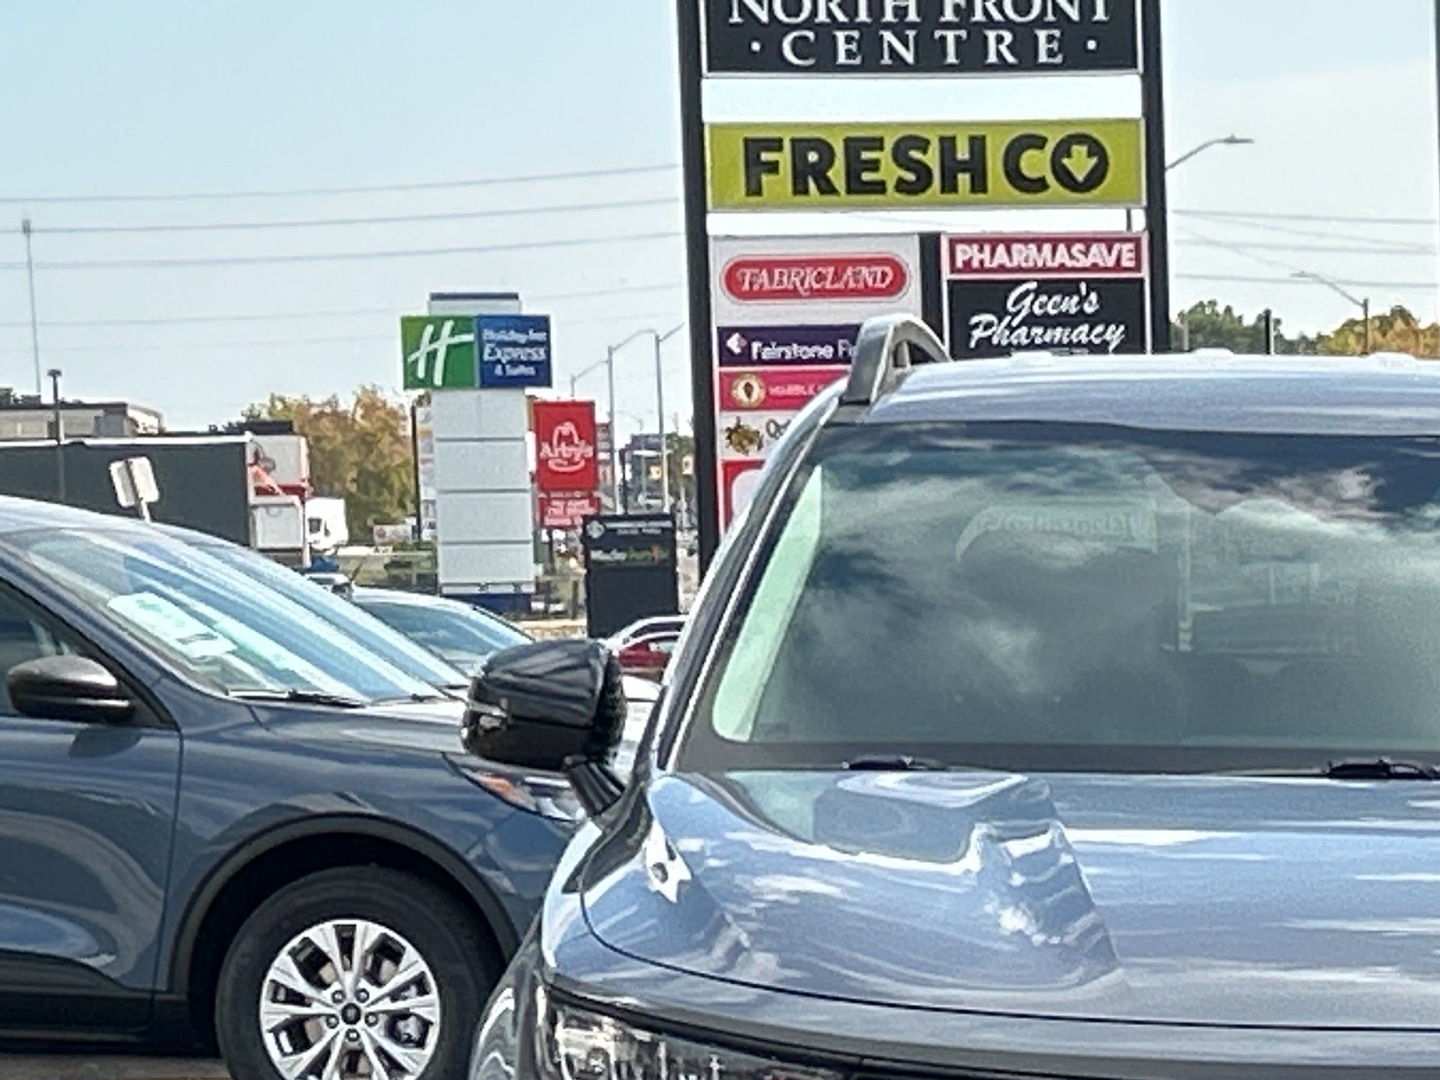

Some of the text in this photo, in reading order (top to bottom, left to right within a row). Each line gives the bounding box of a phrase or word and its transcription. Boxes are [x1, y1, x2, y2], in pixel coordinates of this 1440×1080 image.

[729, 0, 1110, 24] NORTH FRONT
[781, 29, 1063, 66] CENTRE
[954, 242, 1137, 269] PHARMASAVE
[737, 265, 895, 297] FABRICLAND
[968, 313, 1126, 353] Pharmacy
[751, 341, 834, 360] Fairstone
